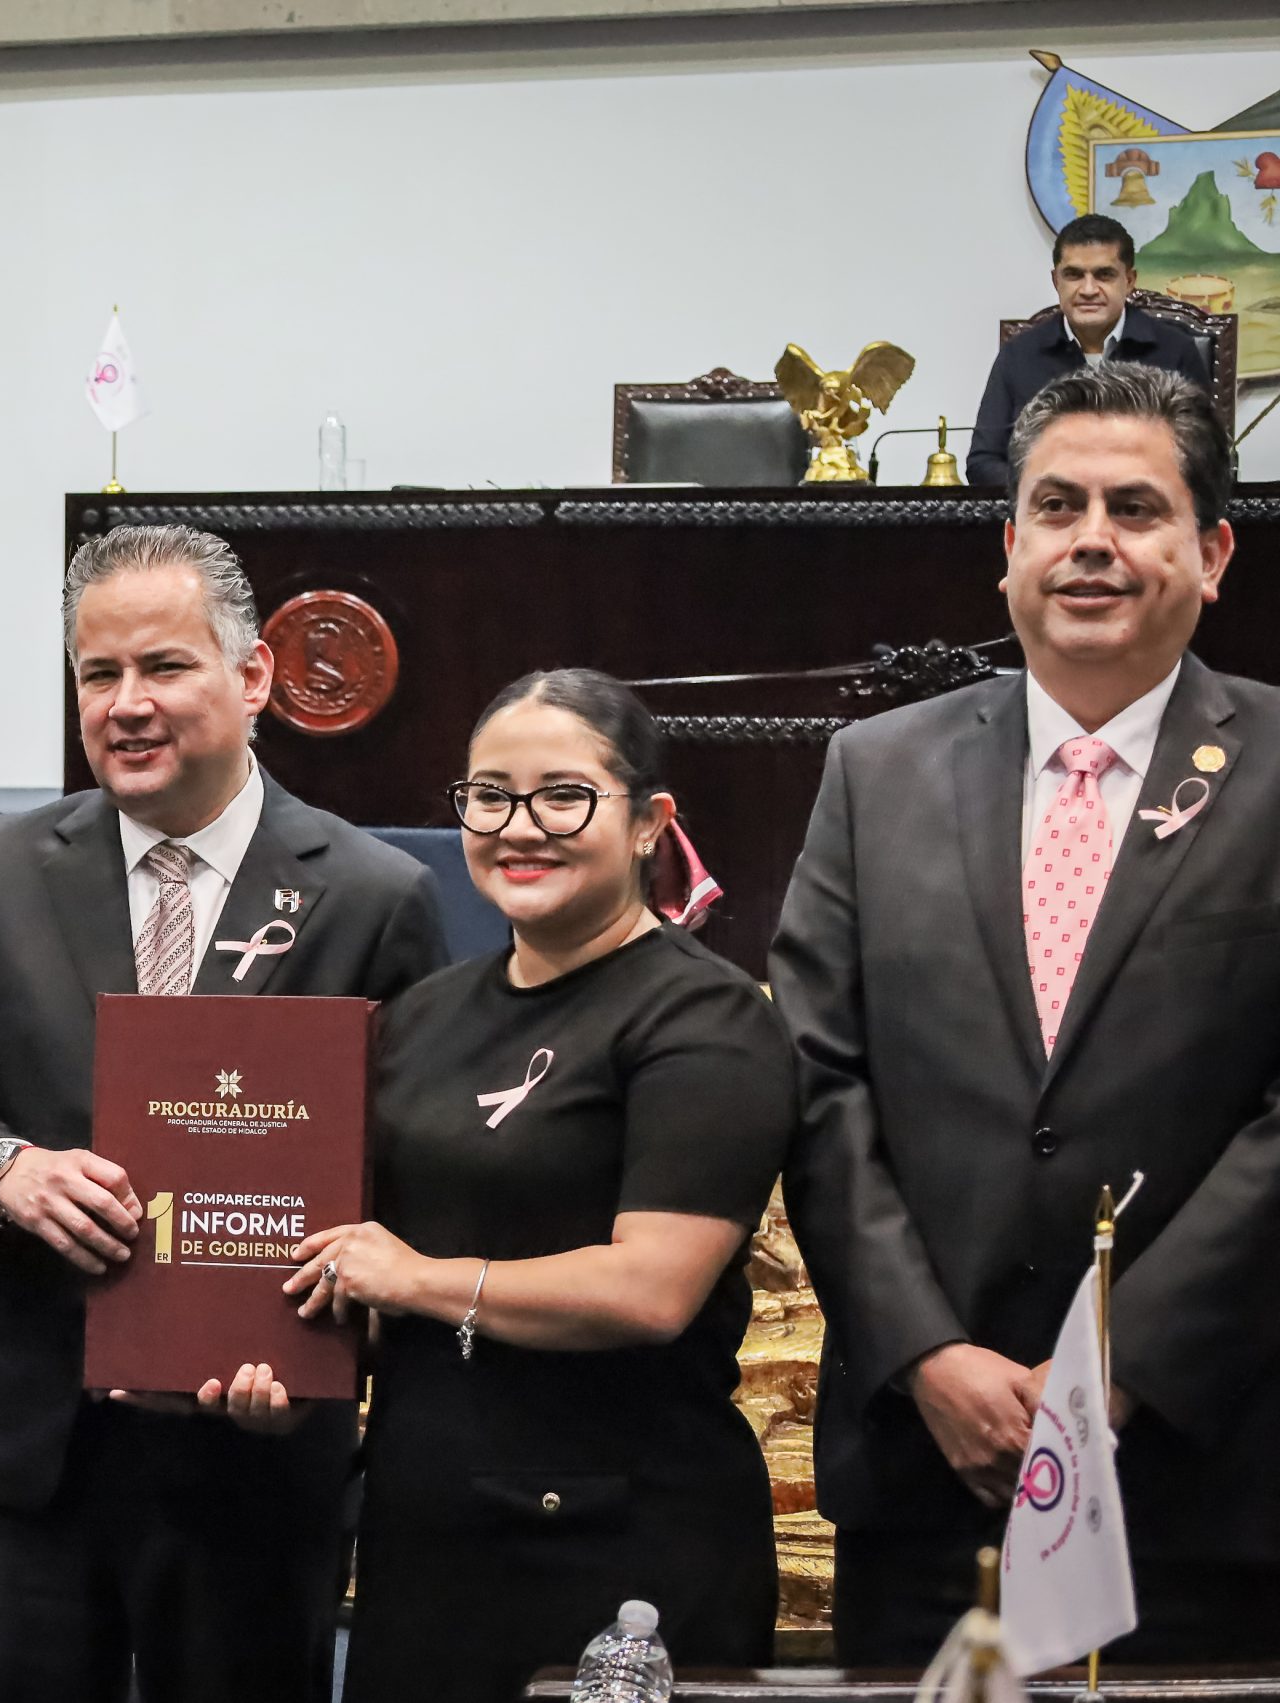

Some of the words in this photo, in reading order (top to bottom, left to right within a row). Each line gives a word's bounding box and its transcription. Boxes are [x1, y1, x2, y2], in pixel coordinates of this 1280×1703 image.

[148, 1100, 310, 1119] PROCURADURÍA
[167, 1118, 218, 1126] PROCURADURÍA
[183, 1192, 305, 1207] COMPARECENCIA
[147, 1192, 174, 1263] 1
[181, 1210, 305, 1237] INFORME
[181, 1240, 203, 1255] DE
[157, 1252, 169, 1262] ER
